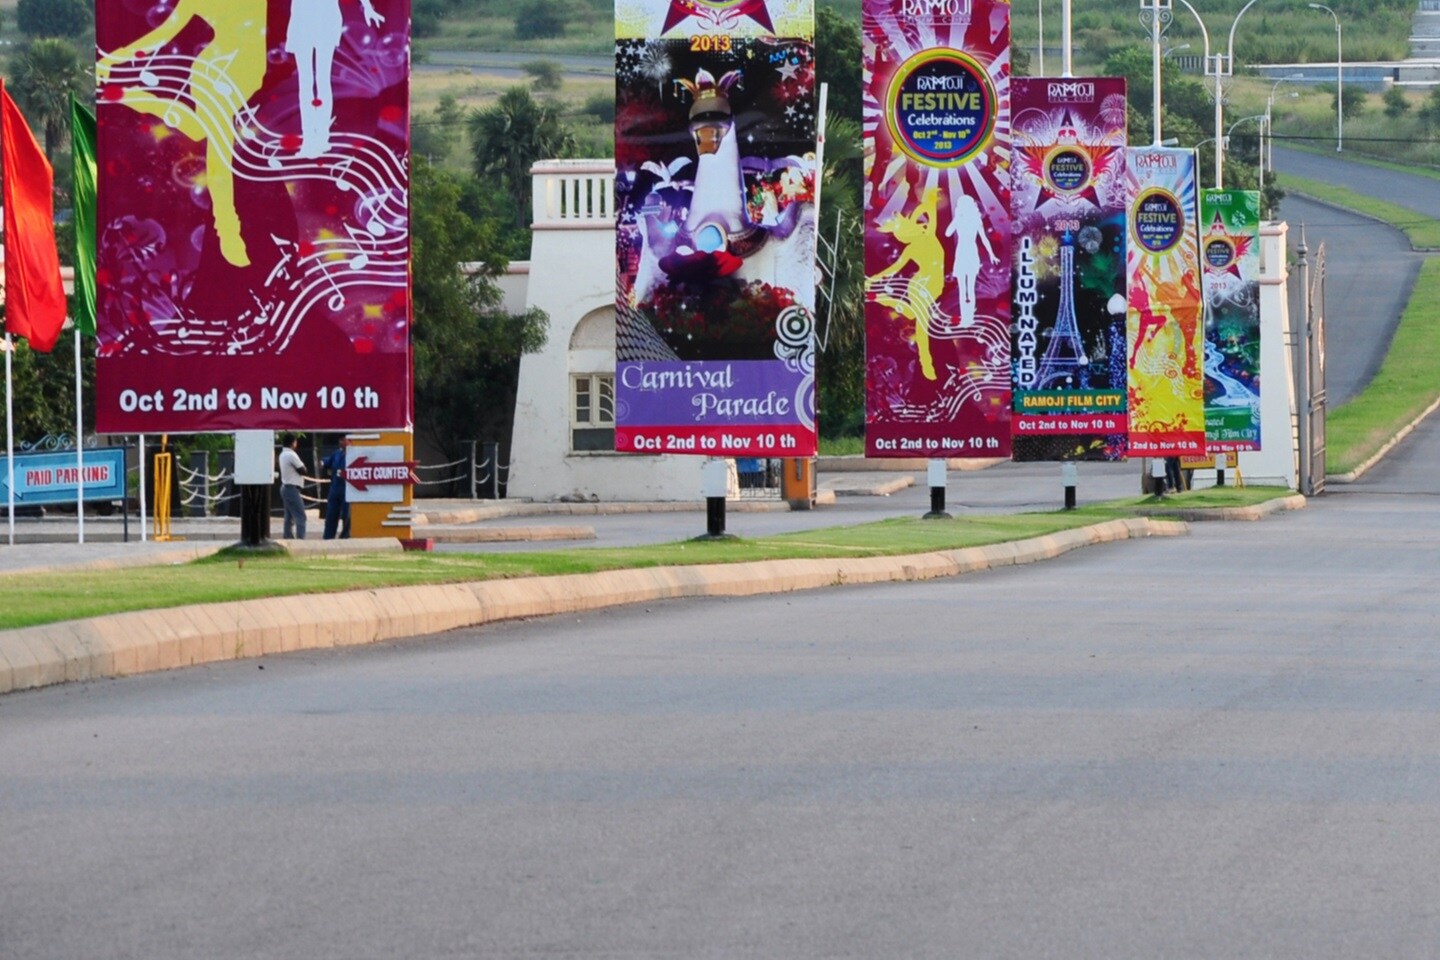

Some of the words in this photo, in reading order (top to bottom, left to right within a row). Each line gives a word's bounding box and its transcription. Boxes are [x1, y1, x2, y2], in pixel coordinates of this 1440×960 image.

[690, 35, 731, 51] 2013
[917, 76, 963, 90] RAMOJI
[1048, 82, 1094, 97] RAMOJI
[902, 93, 981, 110] FESTIVE
[907, 113, 976, 126] Celebrations
[1135, 154, 1177, 168] RAMOJI
[1054, 219, 1080, 231] 2013
[1138, 213, 1176, 223] FESTIVE
[1018, 238, 1036, 384] ILLUMINATED
[622, 362, 733, 390] Carnival
[119, 389, 164, 412] Oct
[172, 388, 218, 411] 2nd
[226, 388, 252, 410] to
[261, 387, 308, 409] Nov
[317, 386, 346, 409] 10
[354, 386, 379, 408] th
[692, 391, 789, 421] Parade
[1023, 396, 1063, 407] RAMOJI
[1067, 395, 1092, 406] FILM
[1096, 395, 1121, 406] CITY
[1019, 420, 1036, 430] Oct
[1039, 420, 1056, 430] 2nd
[1058, 420, 1068, 429] to
[1071, 420, 1089, 429] Nov
[1092, 420, 1103, 429] 10
[1105, 420, 1115, 428] th
[634, 435, 661, 449] Oct
[666, 434, 695, 449] 2nd
[700, 435, 716, 448] to
[721, 433, 751, 448] Nov
[757, 433, 775, 448] 10
[780, 433, 796, 447] th
[875, 438, 897, 449] Oct
[900, 437, 922, 449] 2nd
[926, 437, 938, 448] to
[942, 437, 964, 448] Nov
[968, 437, 982, 448] 10
[986, 437, 999, 448] th
[1133, 441, 1148, 449] 2nd
[1177, 441, 1187, 449] 10
[1188, 441, 1198, 449] th
[26, 469, 52, 486] PAID
[56, 466, 108, 484] PARKING
[347, 467, 372, 480] TICKET
[373, 466, 409, 479] COUNTER
